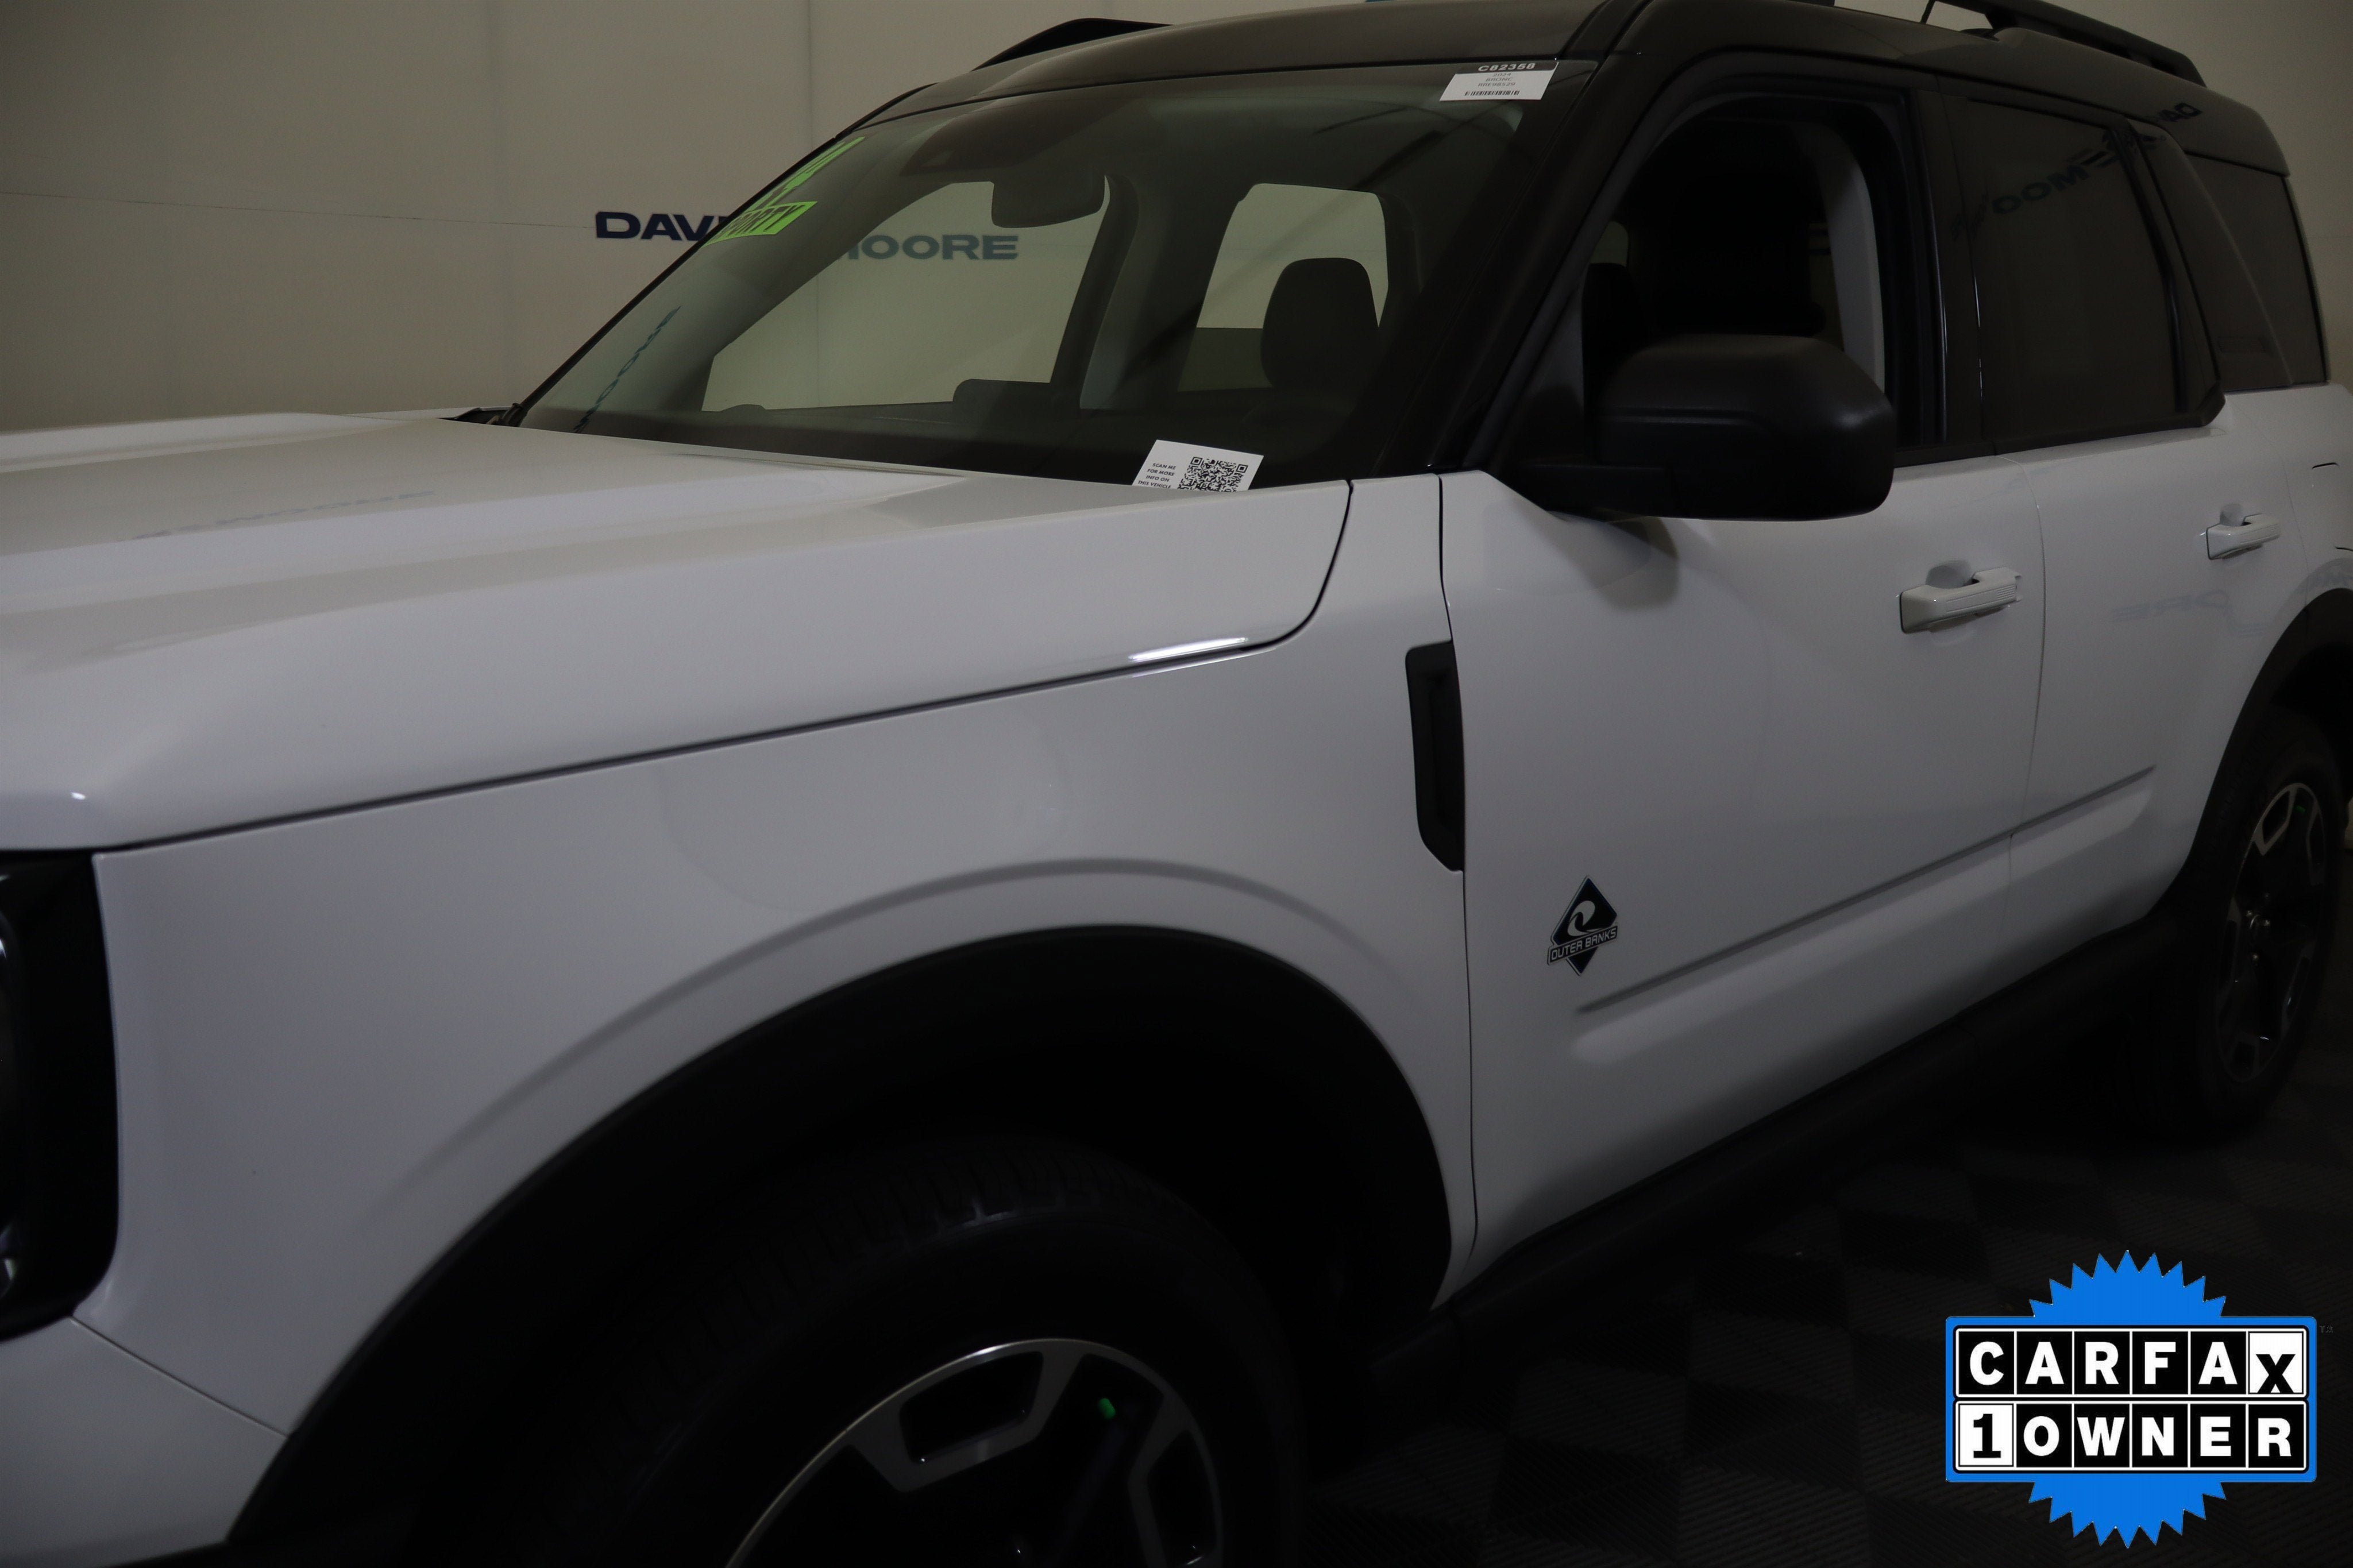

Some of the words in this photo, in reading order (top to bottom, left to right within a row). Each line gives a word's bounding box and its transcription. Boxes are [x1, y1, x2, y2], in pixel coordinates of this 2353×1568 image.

[1478, 63, 1536, 72] C82358
[595, 211, 728, 241] DAV
[1551, 940, 1583, 961] OUTER
[1585, 927, 1617, 948] BANKS
